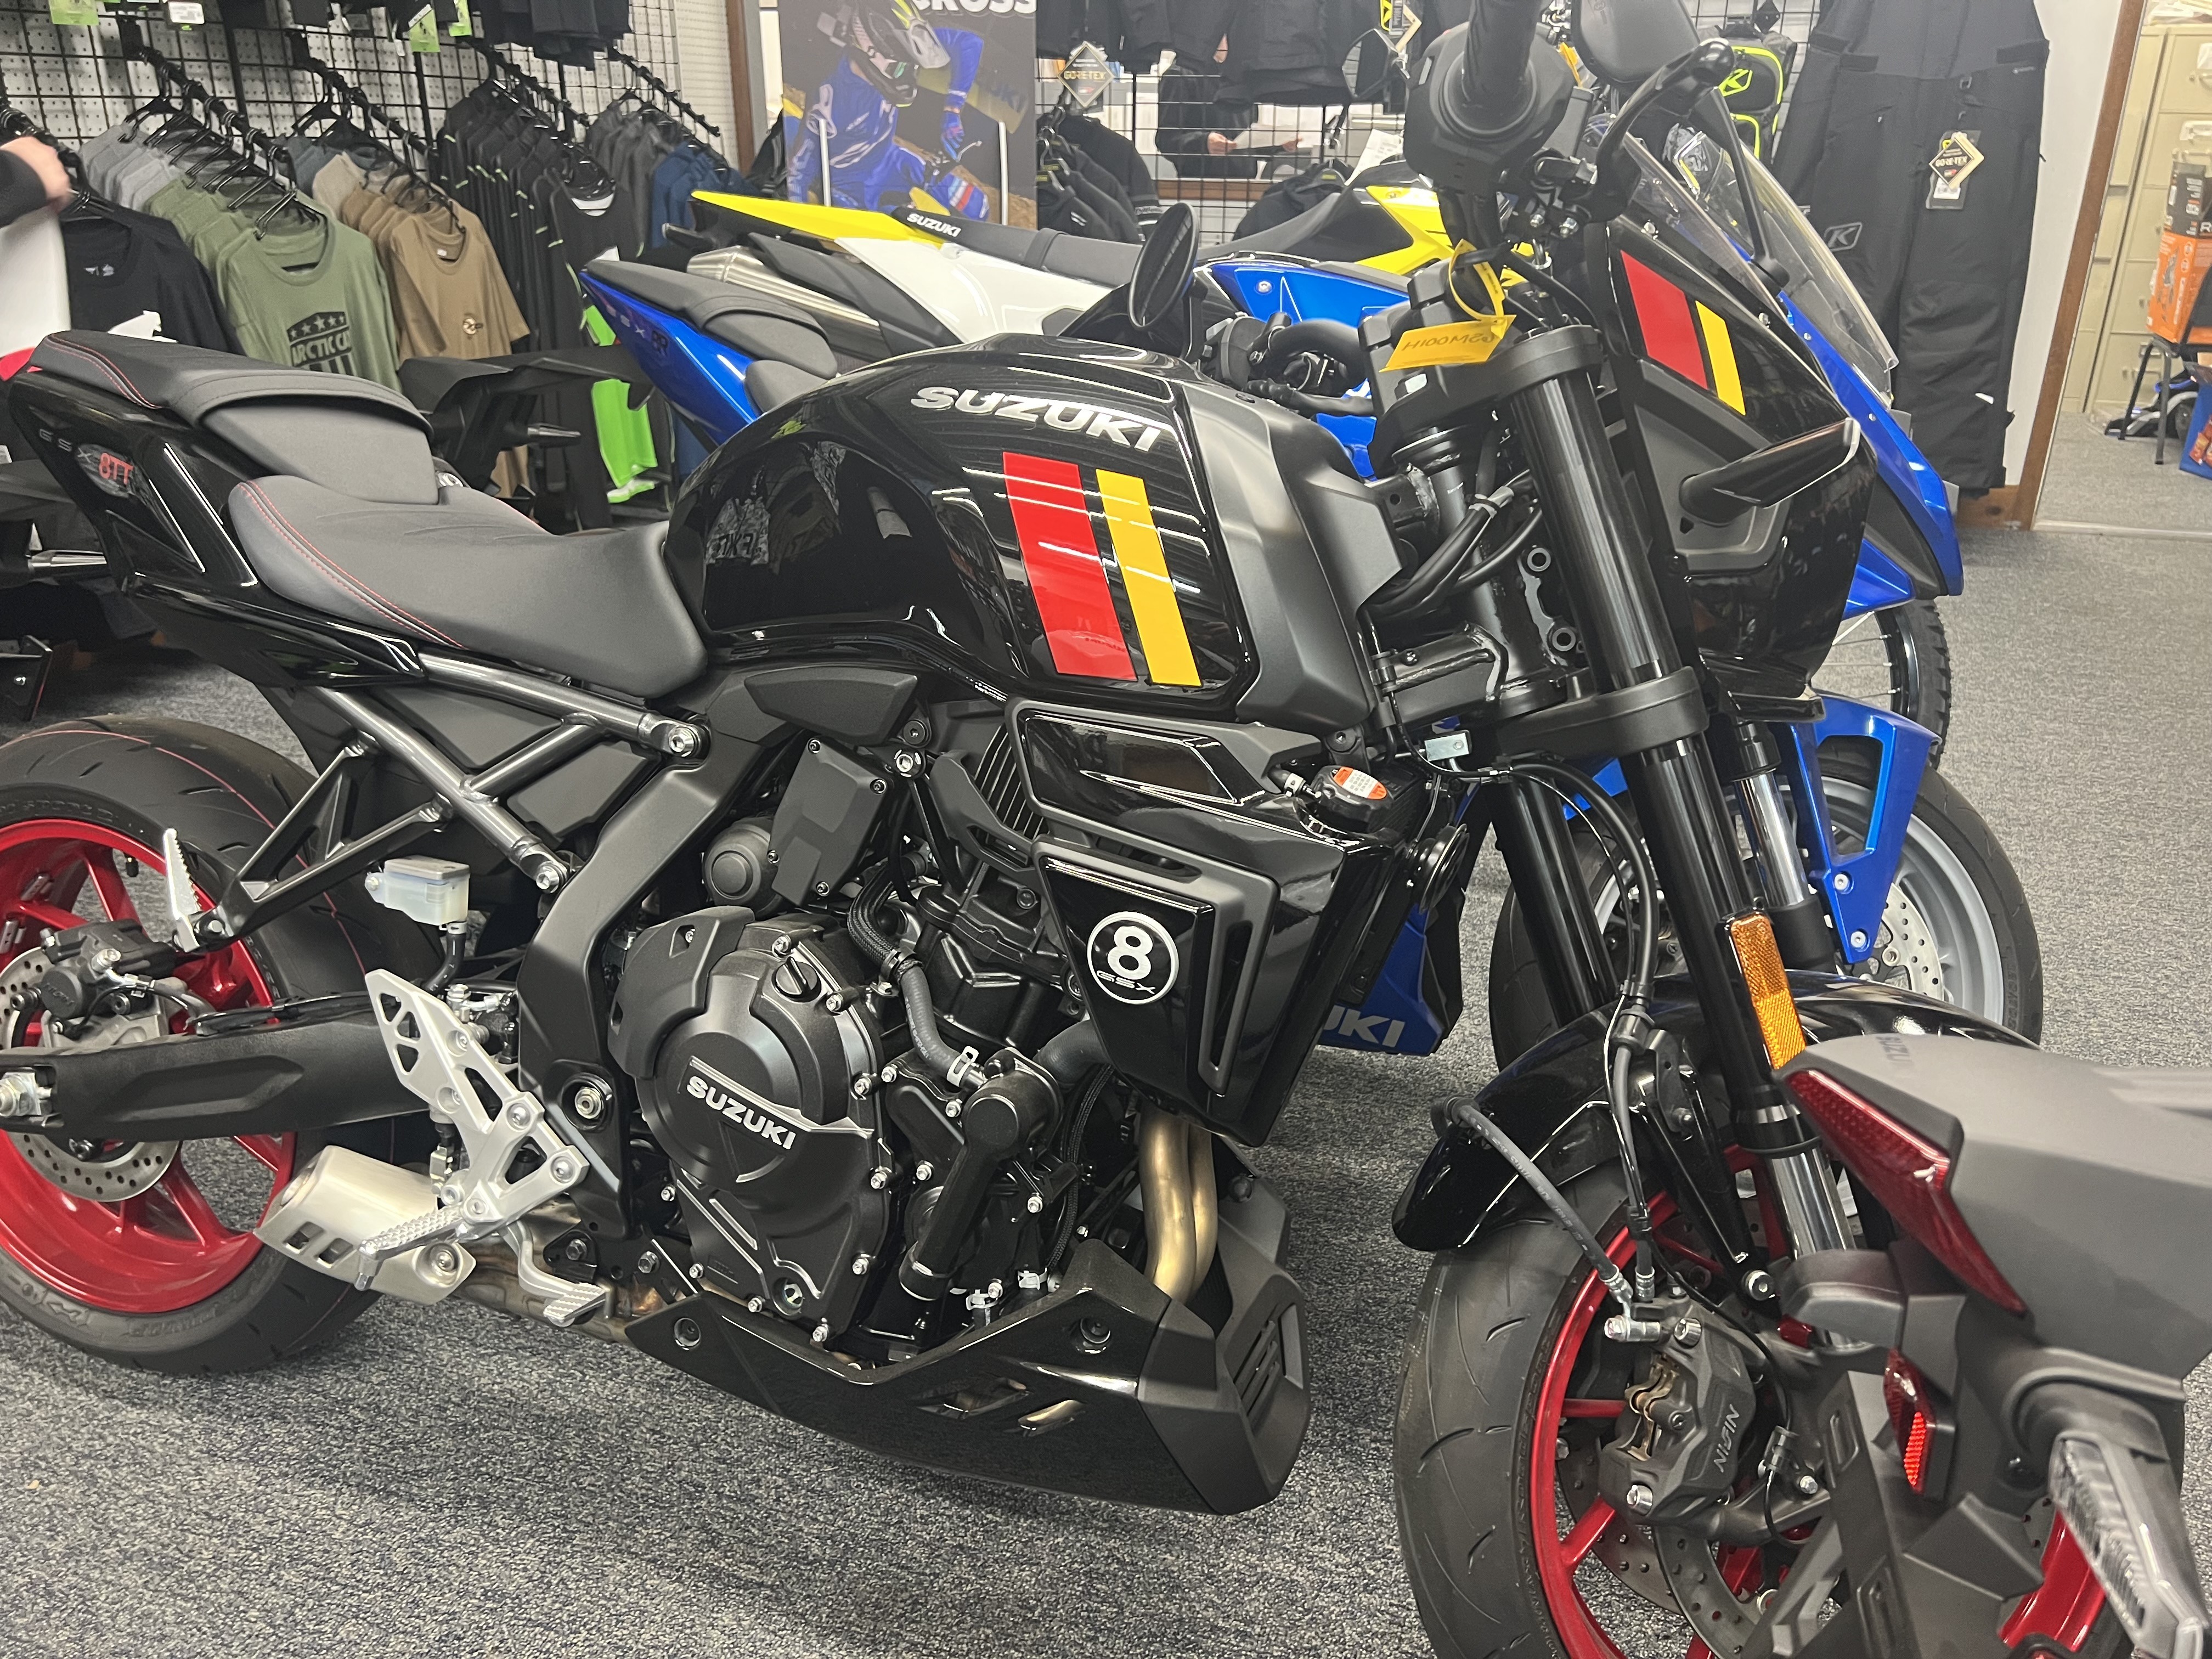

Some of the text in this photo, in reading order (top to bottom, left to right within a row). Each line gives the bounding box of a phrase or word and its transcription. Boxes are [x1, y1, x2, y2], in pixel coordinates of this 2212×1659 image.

[907, 213, 962, 237] SUZUKI
[911, 386, 1162, 453] SUZUKI
[98, 452, 134, 491] 8TT
[1107, 926, 1153, 980] 8
[1096, 970, 1156, 995] GSX
[686, 1075, 797, 1150] SUZUKI
[1713, 1403, 1740, 1473] NISSIN
